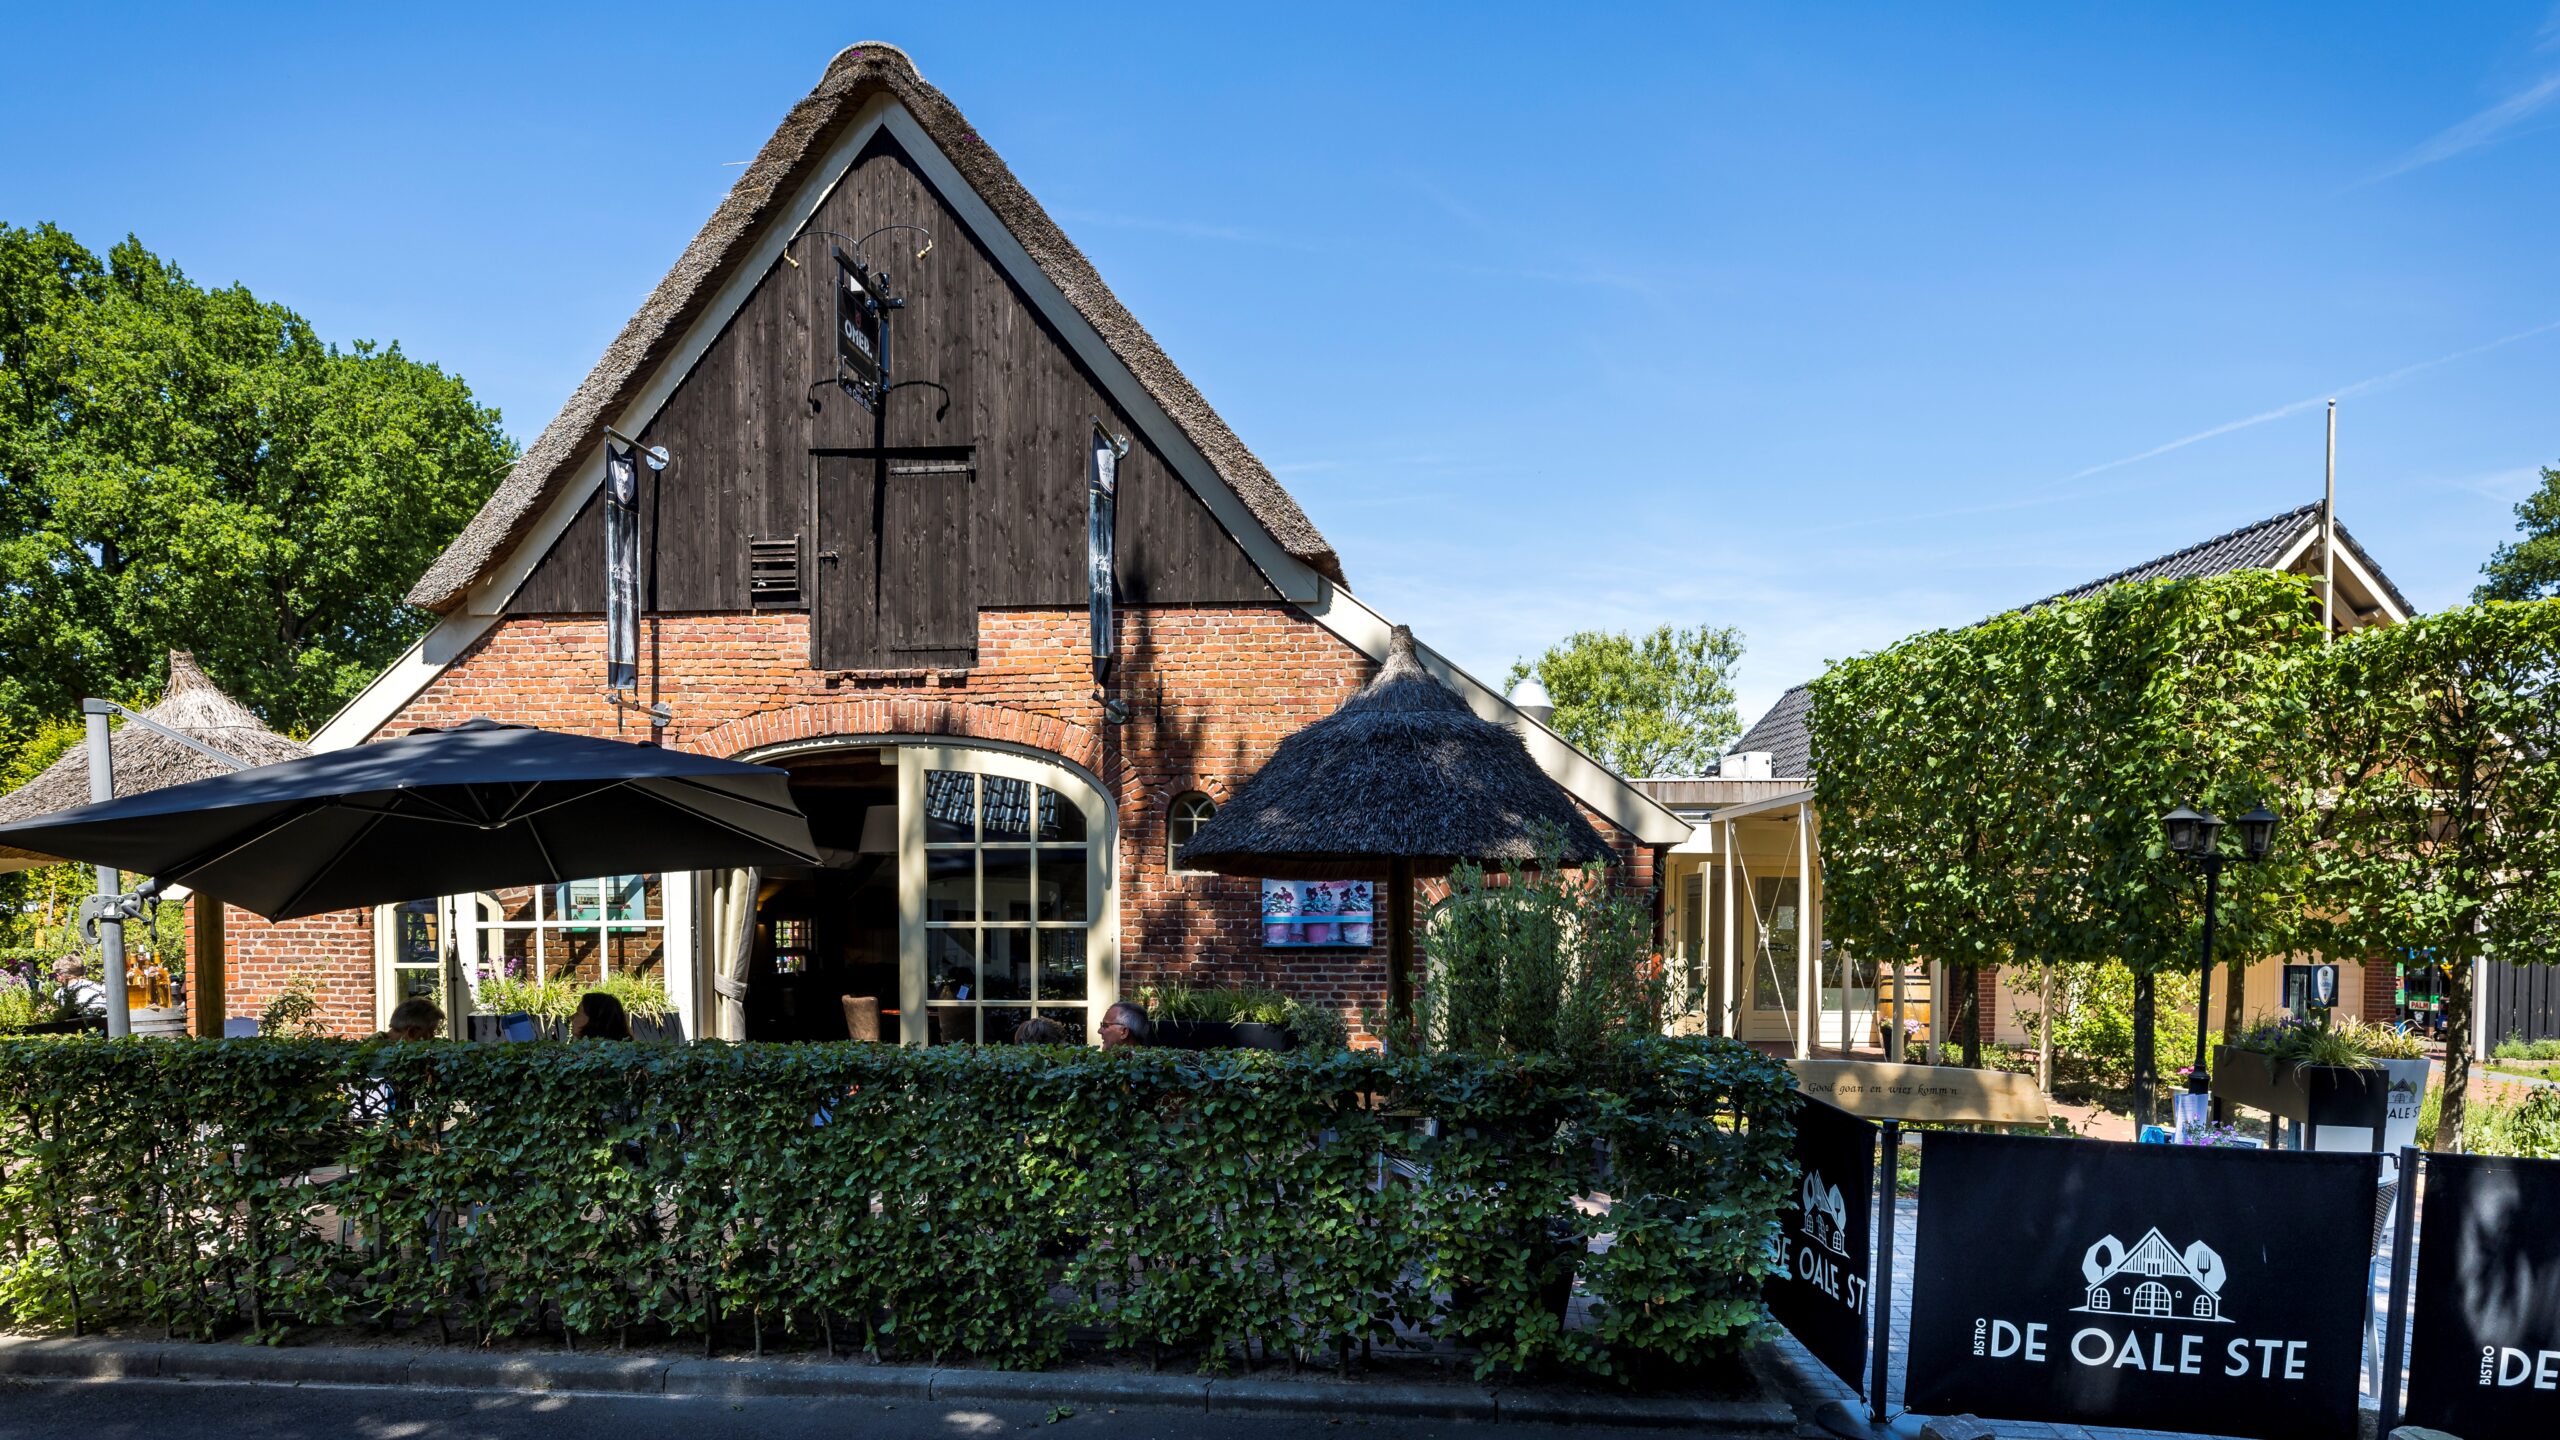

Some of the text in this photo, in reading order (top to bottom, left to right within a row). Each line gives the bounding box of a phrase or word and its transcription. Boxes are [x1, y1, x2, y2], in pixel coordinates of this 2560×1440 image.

[2411, 1001, 2429, 1009] PALM
[1808, 1082, 1833, 1093] Good
[1838, 1085, 1864, 1096] goan
[1869, 1086, 1882, 1094] en
[2388, 1107, 2410, 1119] ALE
[1800, 1247, 1839, 1301] OALE
[1847, 1273, 1867, 1316] ST
[1973, 1318, 1986, 1356] BISTRO
[1990, 1319, 2307, 1380] DE OALE STE
[2479, 1345, 2495, 1385] BISTRO
[2498, 1347, 2560, 1390] DE
